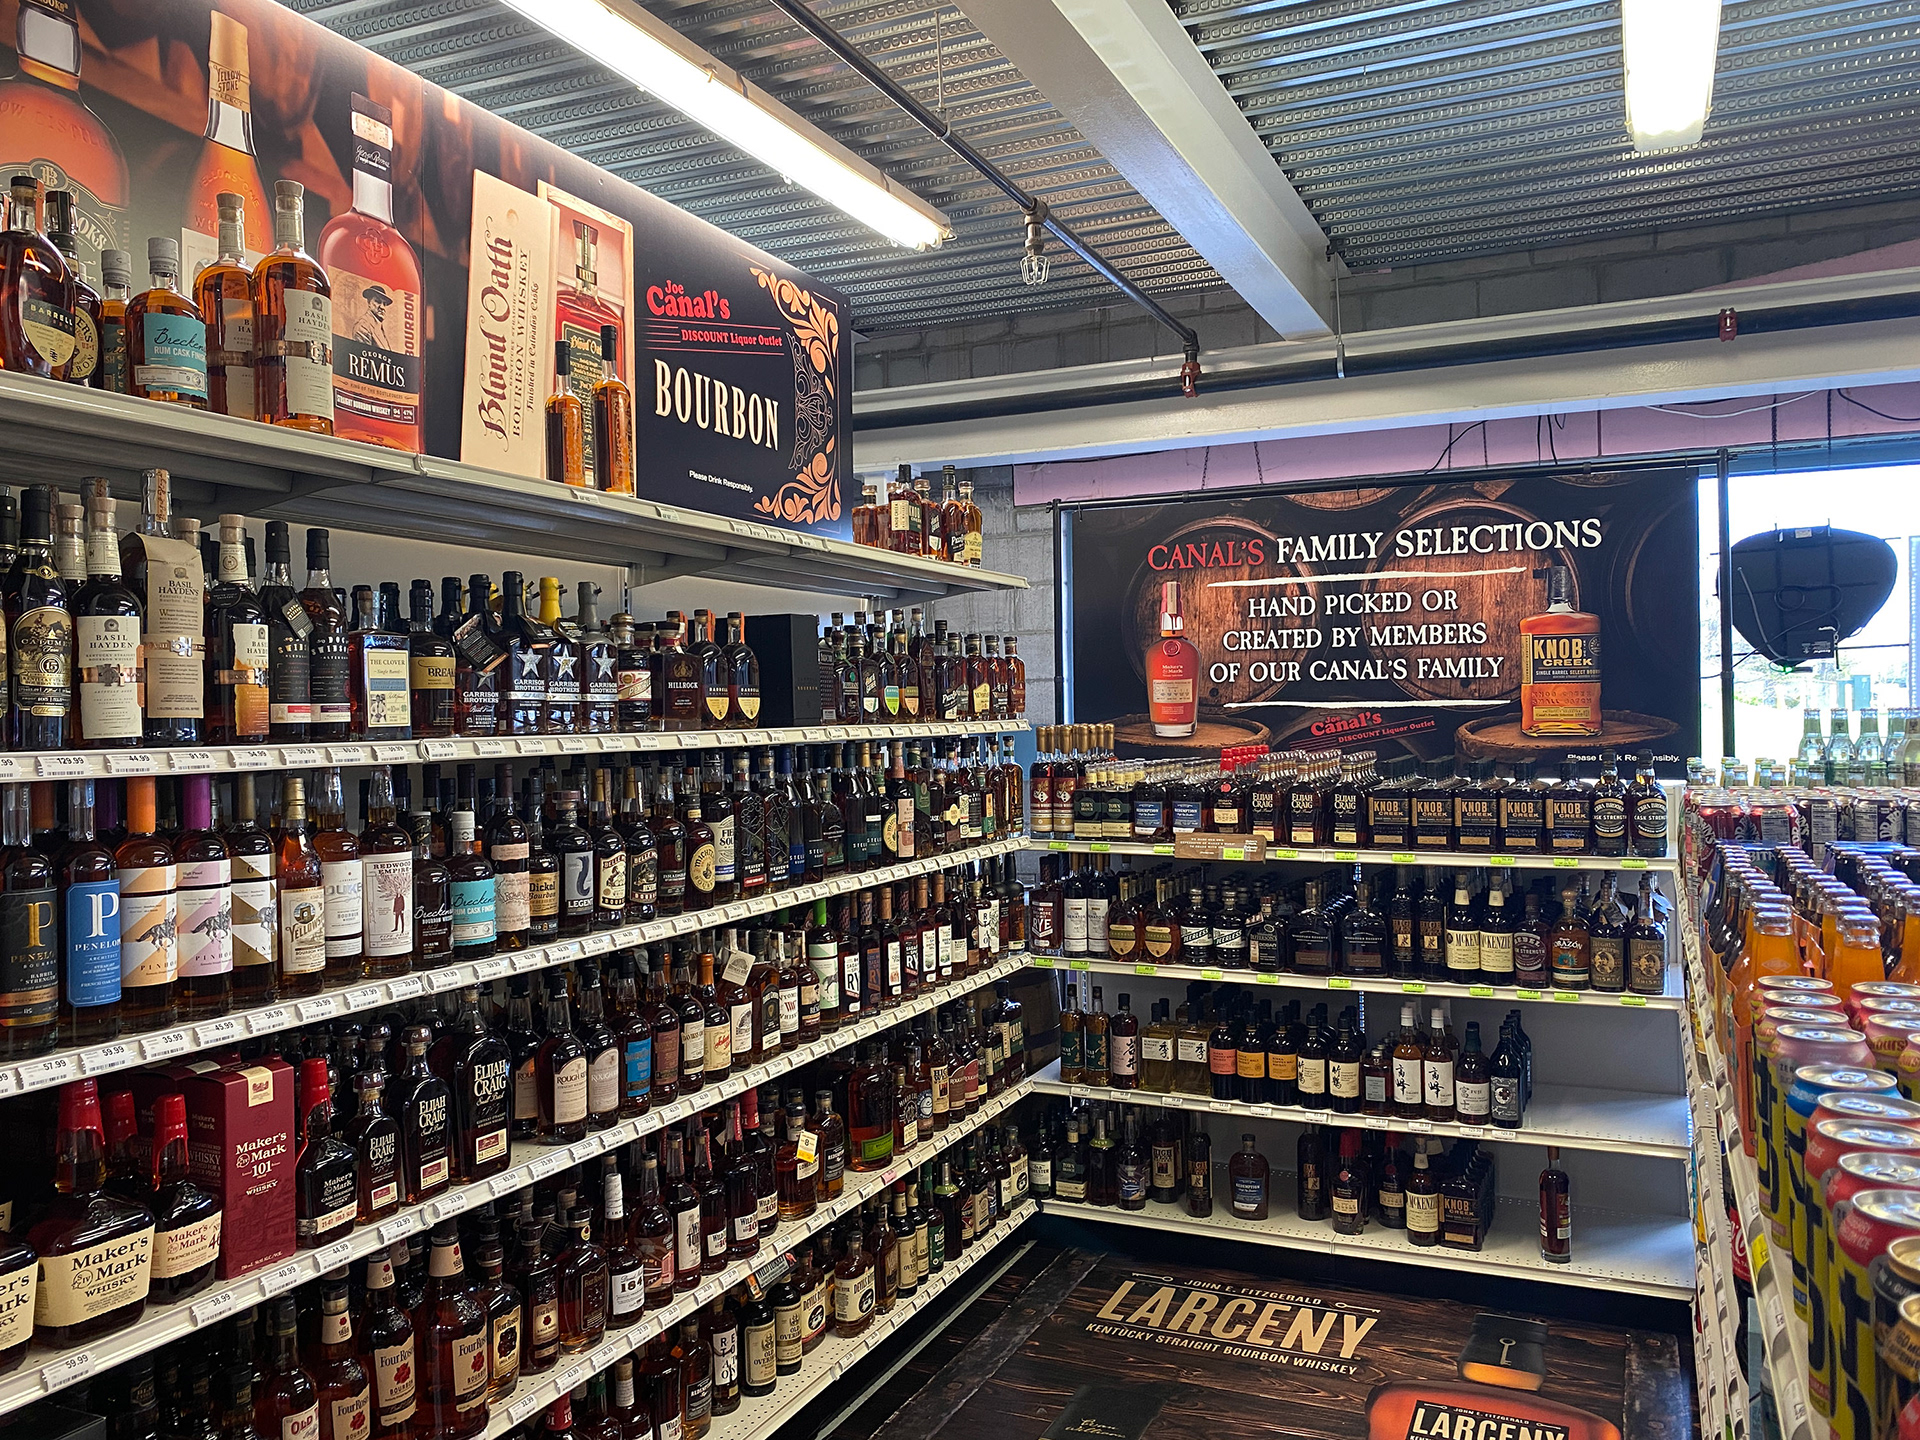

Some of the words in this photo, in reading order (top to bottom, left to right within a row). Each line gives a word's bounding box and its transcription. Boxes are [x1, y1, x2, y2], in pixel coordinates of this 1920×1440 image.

[216, 68, 241, 83] YELLOW
[218, 80, 239, 92] STONE
[517, 250, 529, 337] WHISKEY
[665, 279, 684, 294] Joe
[646, 286, 731, 320] Canal's
[30, 304, 74, 326] BARRELL
[304, 310, 328, 323] BASIL
[403, 292, 415, 356] BOURBON
[681, 329, 728, 344] DISCOUNT
[730, 332, 757, 346] Liquor
[758, 334, 783, 347] Outlet
[154, 346, 170, 355] RUM
[172, 348, 190, 358] CASK
[361, 349, 392, 365] GEORGE
[512, 346, 525, 437] BOURBON
[654, 359, 779, 451] BOURBON
[689, 469, 707, 482] Please
[708, 474, 722, 486] Drink
[1148, 539, 1265, 571] CANAL'S
[1276, 532, 1384, 564] FAMILY
[1395, 518, 1602, 558] SELECTIONS
[158, 586, 199, 596] HAYDEN'S
[168, 580, 193, 588] BASIL
[1248, 596, 1316, 618] HAND
[1325, 592, 1412, 615] PICKED
[1422, 590, 1459, 611] OR
[96, 634, 128, 642] BASIL
[1222, 630, 1322, 651] CREATED
[1331, 627, 1361, 648] BY
[1370, 622, 1487, 647] MEMBERS
[1534, 638, 1583, 659] KNOB
[48, 661, 58, 672] 15
[1209, 662, 1241, 683] OF
[1249, 661, 1301, 682] OUR
[1309, 657, 1408, 682] CANAL'S
[1417, 656, 1504, 680] FAMILY
[1543, 658, 1593, 666] CREEK
[1310, 712, 1382, 736] Canal's
[1325, 716, 1341, 724] Joe
[1338, 730, 1380, 743] DISCOUNT
[1382, 725, 1408, 735] Liquor
[1409, 720, 1435, 730] Outlet
[56, 757, 84, 765] 129.99
[1252, 793, 1273, 801] ELIJAH
[1252, 799, 1273, 808] CRAIG
[1291, 793, 1313, 801] ELIJAH
[1291, 800, 1313, 809] CRAIG
[1334, 793, 1356, 801] ELIJAH
[1334, 801, 1356, 809] CRAIG
[1373, 801, 1399, 812] KNOB
[1417, 802, 1442, 812] KNOB
[1461, 801, 1487, 813] KNOB
[1507, 802, 1534, 813] KNOB
[1554, 802, 1581, 814] KNOB
[529, 882, 556, 891] Dickel
[86, 892, 119, 938] P
[542, 922, 548, 930] 8
[1033, 919, 1051, 929] RYE
[1183, 928, 1210, 942] PEERLESS
[1215, 930, 1242, 945] PEERLESS
[42, 1060, 67, 1071] 57.99
[101, 1045, 125, 1057] 59.99
[162, 1034, 184, 1044] 35.99
[215, 1021, 234, 1031] 45.99
[265, 1010, 283, 1020] 56.99
[315, 999, 331, 1008] 35.99
[361, 989, 377, 997] 37.99
[474, 1060, 506, 1081] ELIJAH
[556, 1073, 578, 1084] ROUGH
[474, 1075, 506, 1097] CRAIG
[419, 1095, 446, 1114] ELIJAH
[419, 1108, 446, 1129] CRAIG
[235, 1132, 287, 1155] Maker's
[370, 1133, 395, 1151] ELIJAH
[250, 1145, 286, 1163] Mark
[370, 1144, 395, 1161] CRAIG
[252, 1160, 272, 1177] 101
[246, 1180, 278, 1196] WHISKY
[324, 1172, 353, 1188] Maker's
[333, 1179, 353, 1193] Mark
[1444, 1198, 1468, 1213] KNOB
[166, 1224, 208, 1244] Maker's
[179, 1235, 207, 1251] Mark
[71, 1236, 148, 1272] Maker's
[95, 1253, 147, 1281] Mark
[65, 1354, 89, 1369] 59.99
[211, 1293, 231, 1307] 38.99
[279, 1265, 296, 1278] 40.99
[332, 1243, 349, 1254] 44.99
[395, 1217, 410, 1228] 22.99
[85, 1273, 138, 1298] WHISKY
[1184, 1279, 1222, 1292] JOHN
[1225, 1285, 1237, 1294] E.
[1241, 1287, 1322, 1305] FITZGERALD
[1096, 1280, 1380, 1359] LARCENY
[459, 1341, 477, 1357] Four
[1085, 1322, 1153, 1342] KENTUCKY
[1155, 1333, 1221, 1354] STRAIGHT
[1223, 1345, 1289, 1364] BOURBON
[1292, 1356, 1358, 1376] WHISKEY
[380, 1353, 399, 1367] Four
[337, 1403, 356, 1416] Four
[1453, 1407, 1477, 1416] JOHN
[1485, 1412, 1529, 1425] FITZGERALD
[291, 1415, 312, 1435] OLD
[1412, 1407, 1565, 1440] LARCENY
